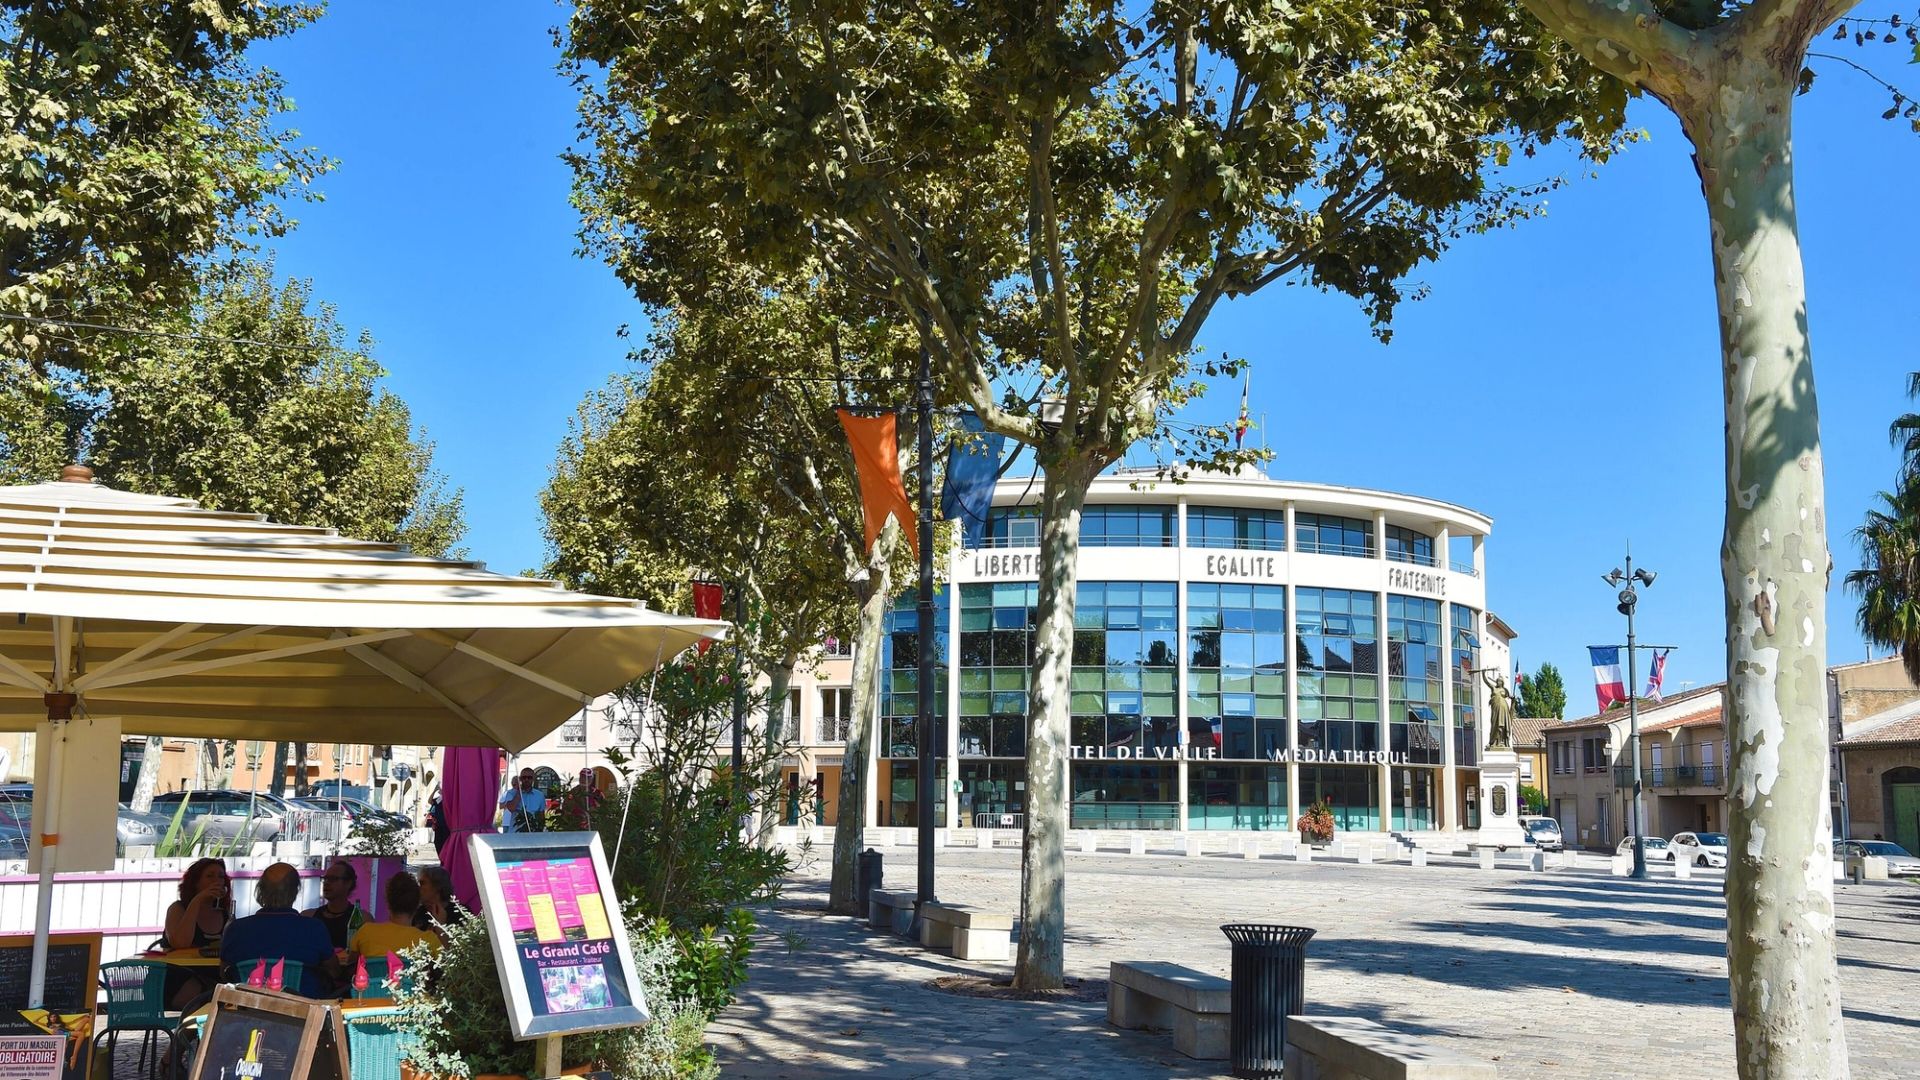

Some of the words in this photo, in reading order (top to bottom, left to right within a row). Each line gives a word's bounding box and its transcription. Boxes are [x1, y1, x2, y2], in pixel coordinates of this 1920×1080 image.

[975, 554, 1040, 576] LIBERTE
[1207, 555, 1274, 577] EGALITE
[1389, 567, 1446, 596] FRATERNITE
[1070, 745, 1107, 760] TEL
[1117, 745, 1144, 760] DE
[1154, 746, 1217, 760] VILLE
[524, 947, 539, 959] Le
[542, 944, 580, 958] Grand
[582, 941, 610, 955] Café
[551, 958, 579, 966] Restaurant
[0, 1041, 19, 1050] PORT
[20, 1041, 29, 1050] DU
[30, 1041, 57, 1050] MASQUE
[0, 1051, 56, 1063] OBLIGATOIRE
